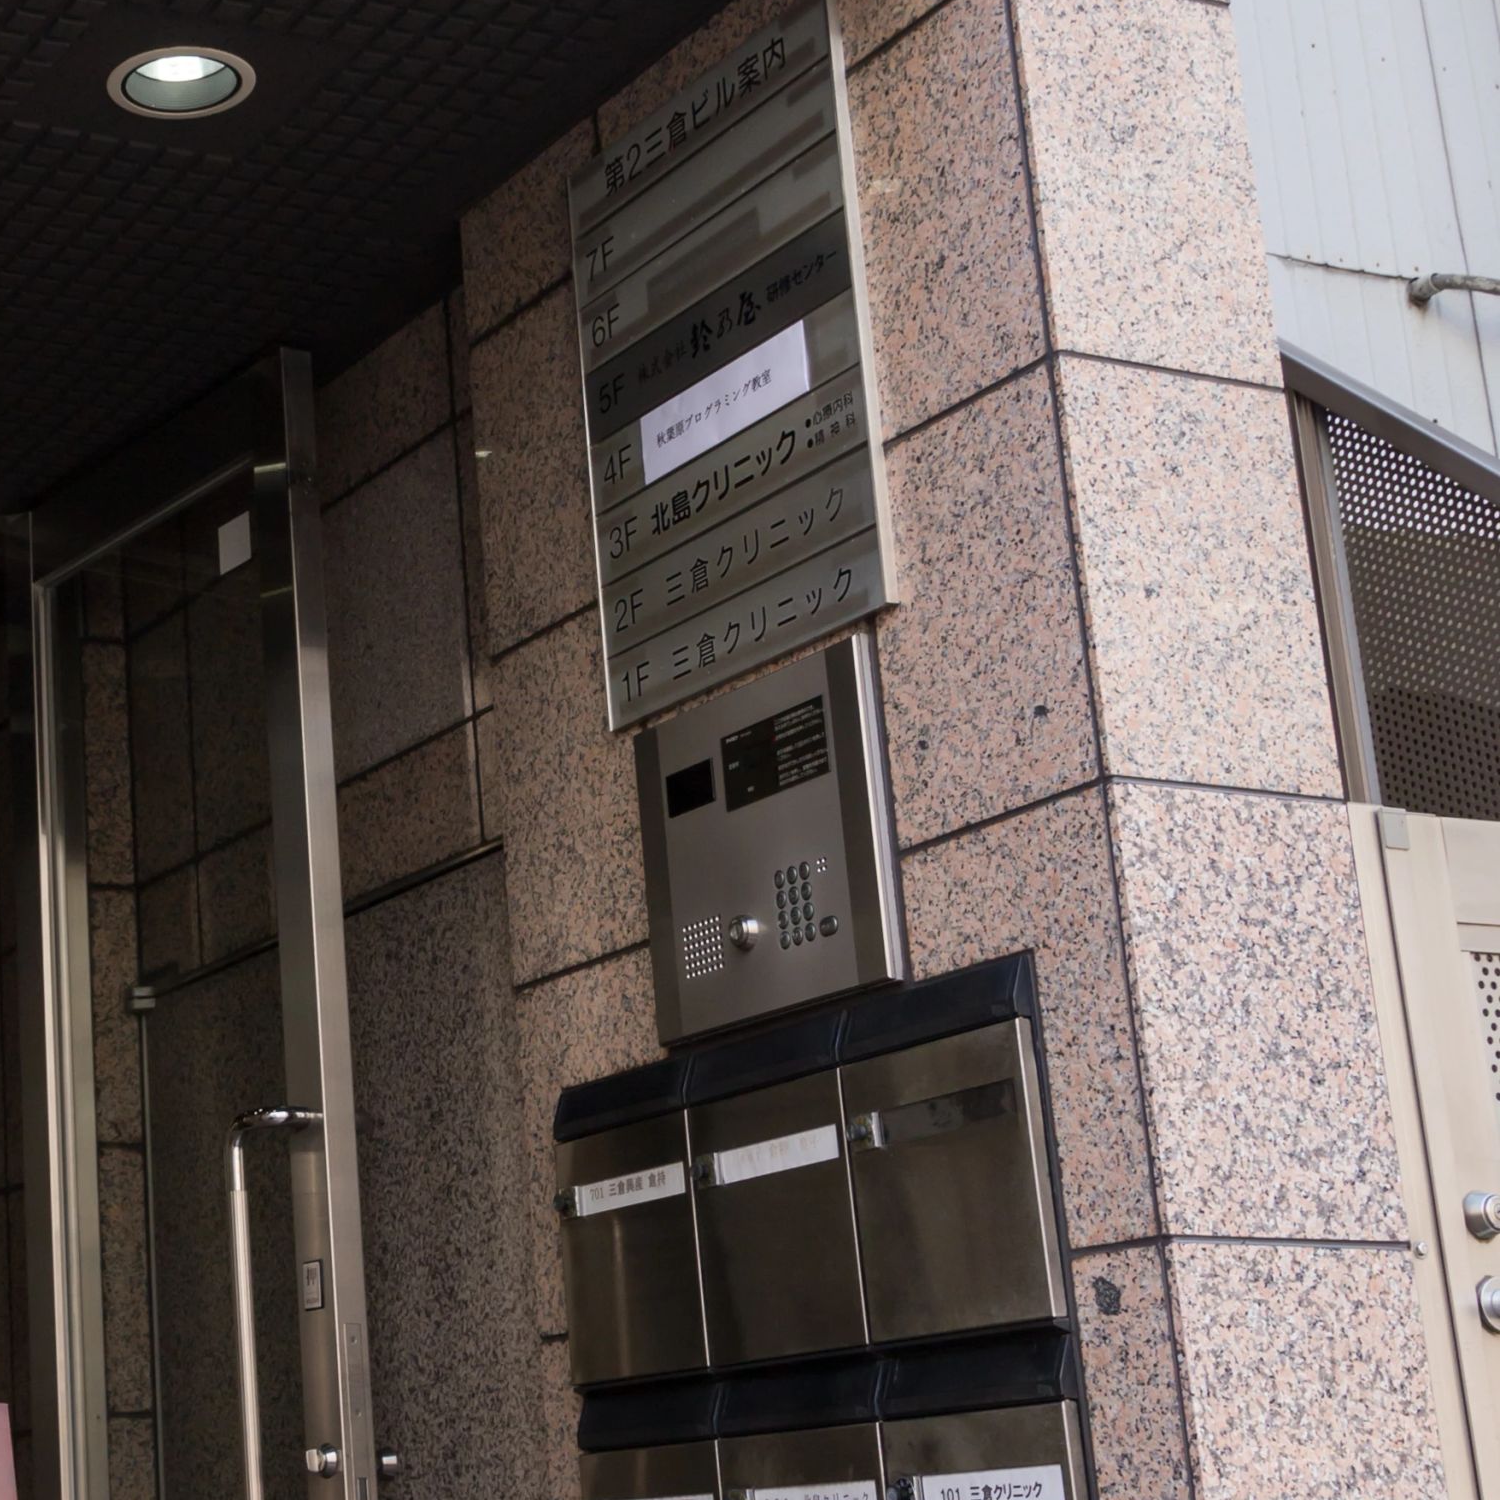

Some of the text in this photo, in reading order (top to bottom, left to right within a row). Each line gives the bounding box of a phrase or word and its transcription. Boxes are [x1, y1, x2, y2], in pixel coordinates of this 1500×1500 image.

[604, 37, 786, 198] 第2三倉ビル案内
[586, 236, 615, 283] 7F
[591, 303, 620, 348] 6F
[599, 374, 625, 414] 5F
[604, 369, 772, 485] 4F 秋葉原プログラミング教室
[609, 429, 797, 559] 3F 北島クリニック
[615, 487, 844, 633] 2F 三倉クリニック
[622, 568, 853, 702] 1F 三倉クリニック
